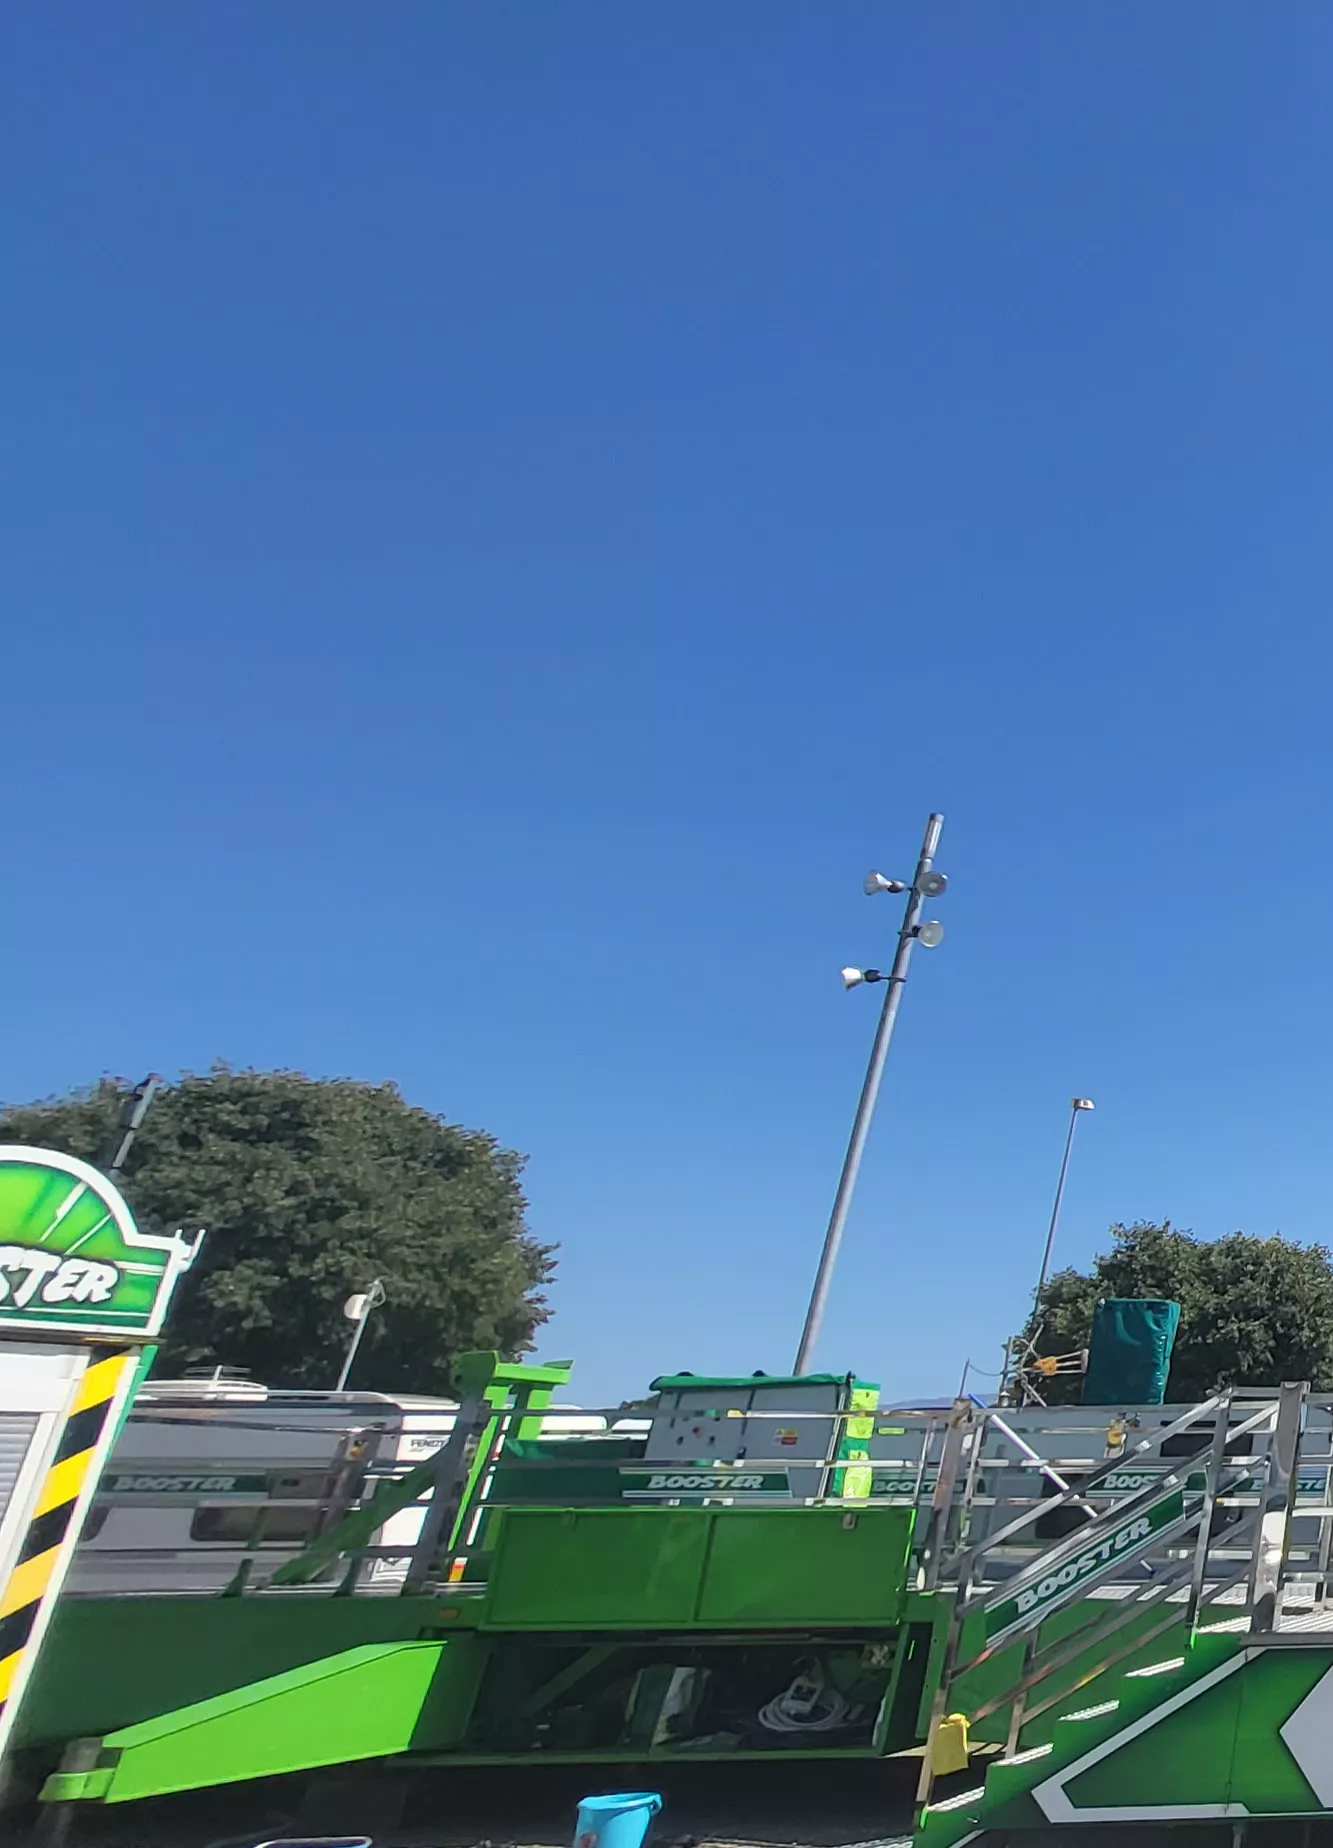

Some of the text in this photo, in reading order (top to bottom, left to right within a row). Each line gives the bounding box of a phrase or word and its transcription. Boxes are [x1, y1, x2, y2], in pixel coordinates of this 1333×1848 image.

[113, 1476, 237, 1491] BOOSTER
[648, 1475, 764, 1489] BOOSTER
[1015, 1517, 1152, 1614] BOOSTER
